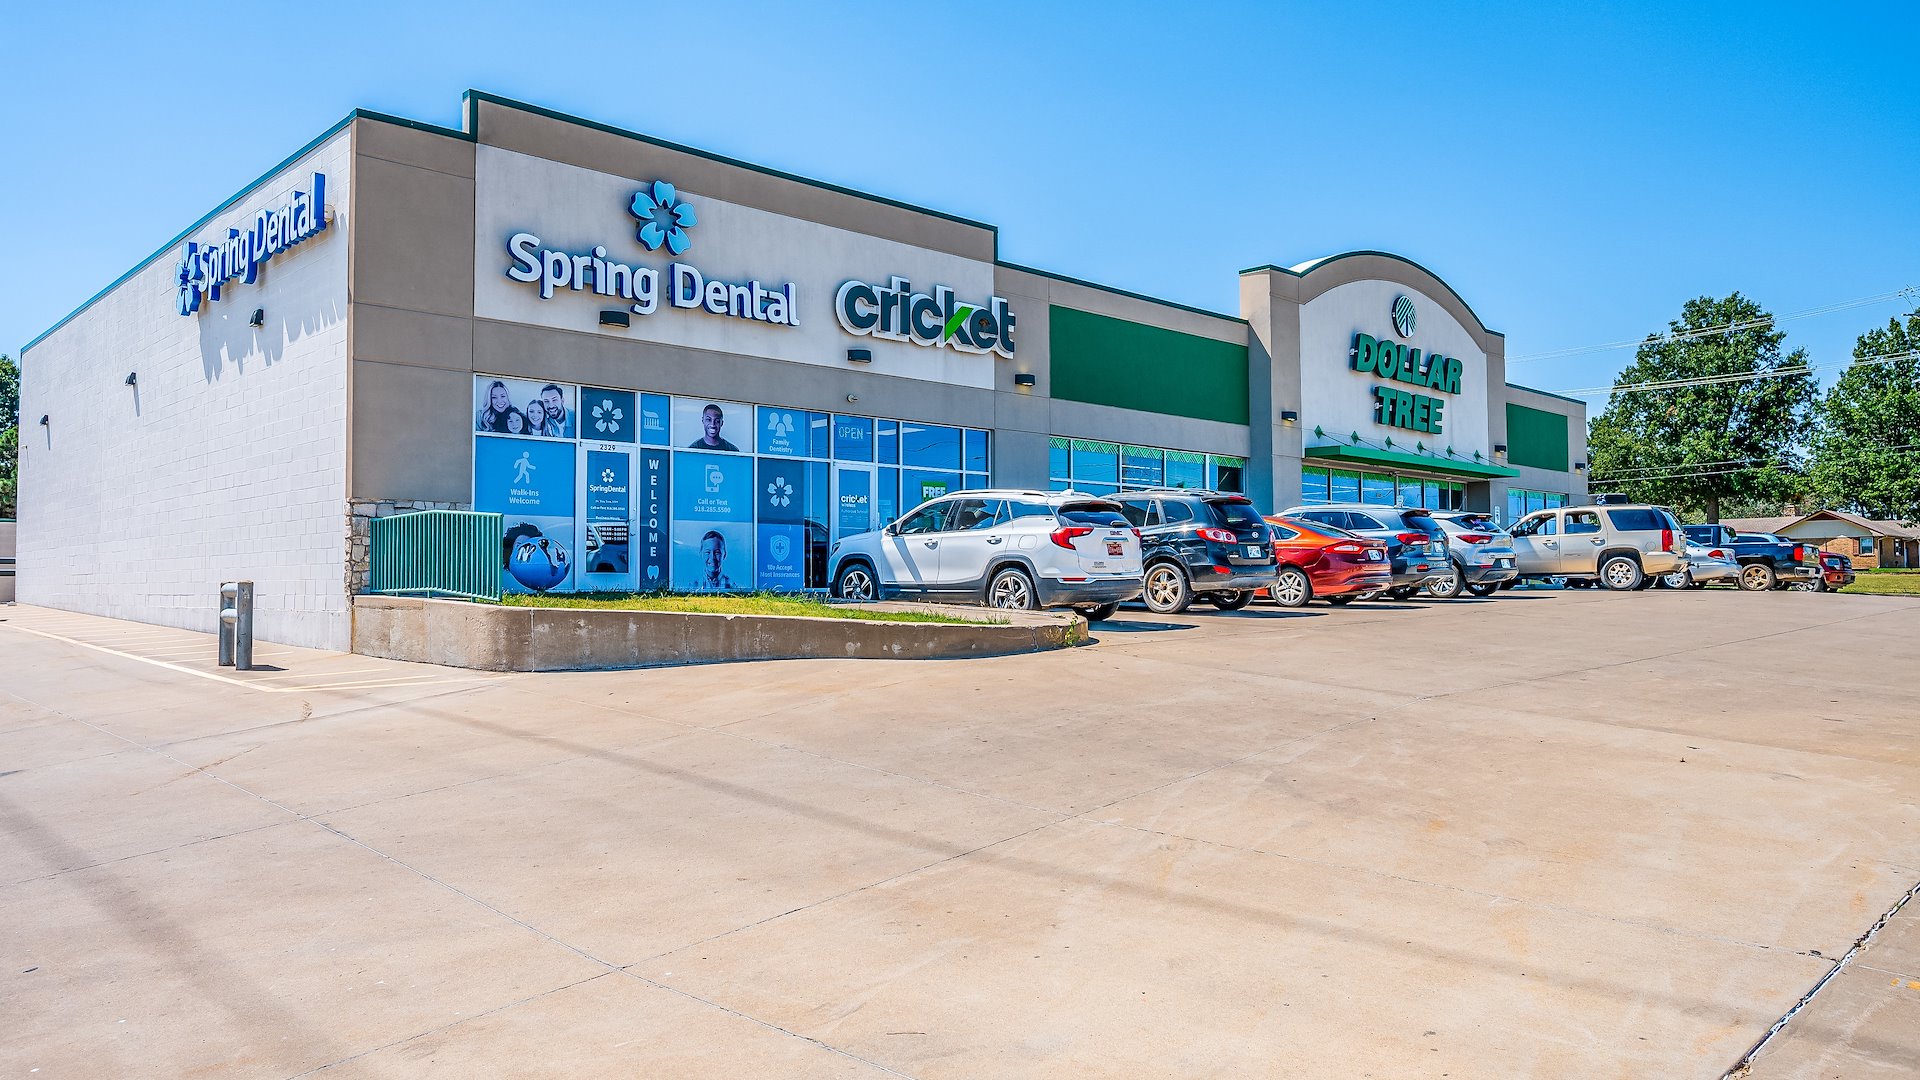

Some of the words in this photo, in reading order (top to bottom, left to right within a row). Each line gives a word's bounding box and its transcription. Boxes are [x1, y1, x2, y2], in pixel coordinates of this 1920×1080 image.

[199, 228, 257, 301] Spring
[253, 172, 326, 263] Dental
[506, 232, 659, 315] Spring
[670, 262, 800, 326] Dental
[836, 276, 1016, 359] cricket
[1354, 332, 1463, 395] DOLLAR
[1375, 386, 1445, 435] TREE
[838, 426, 864, 440] OPEN
[769, 445, 793, 454] Dentistry
[772, 438, 790, 447] Family
[510, 488, 539, 497] Walk-Ins
[841, 494, 868, 504] cricket
[922, 486, 946, 498] FREE
[509, 497, 540, 505] Welcome
[648, 459, 660, 557] WELCOME
